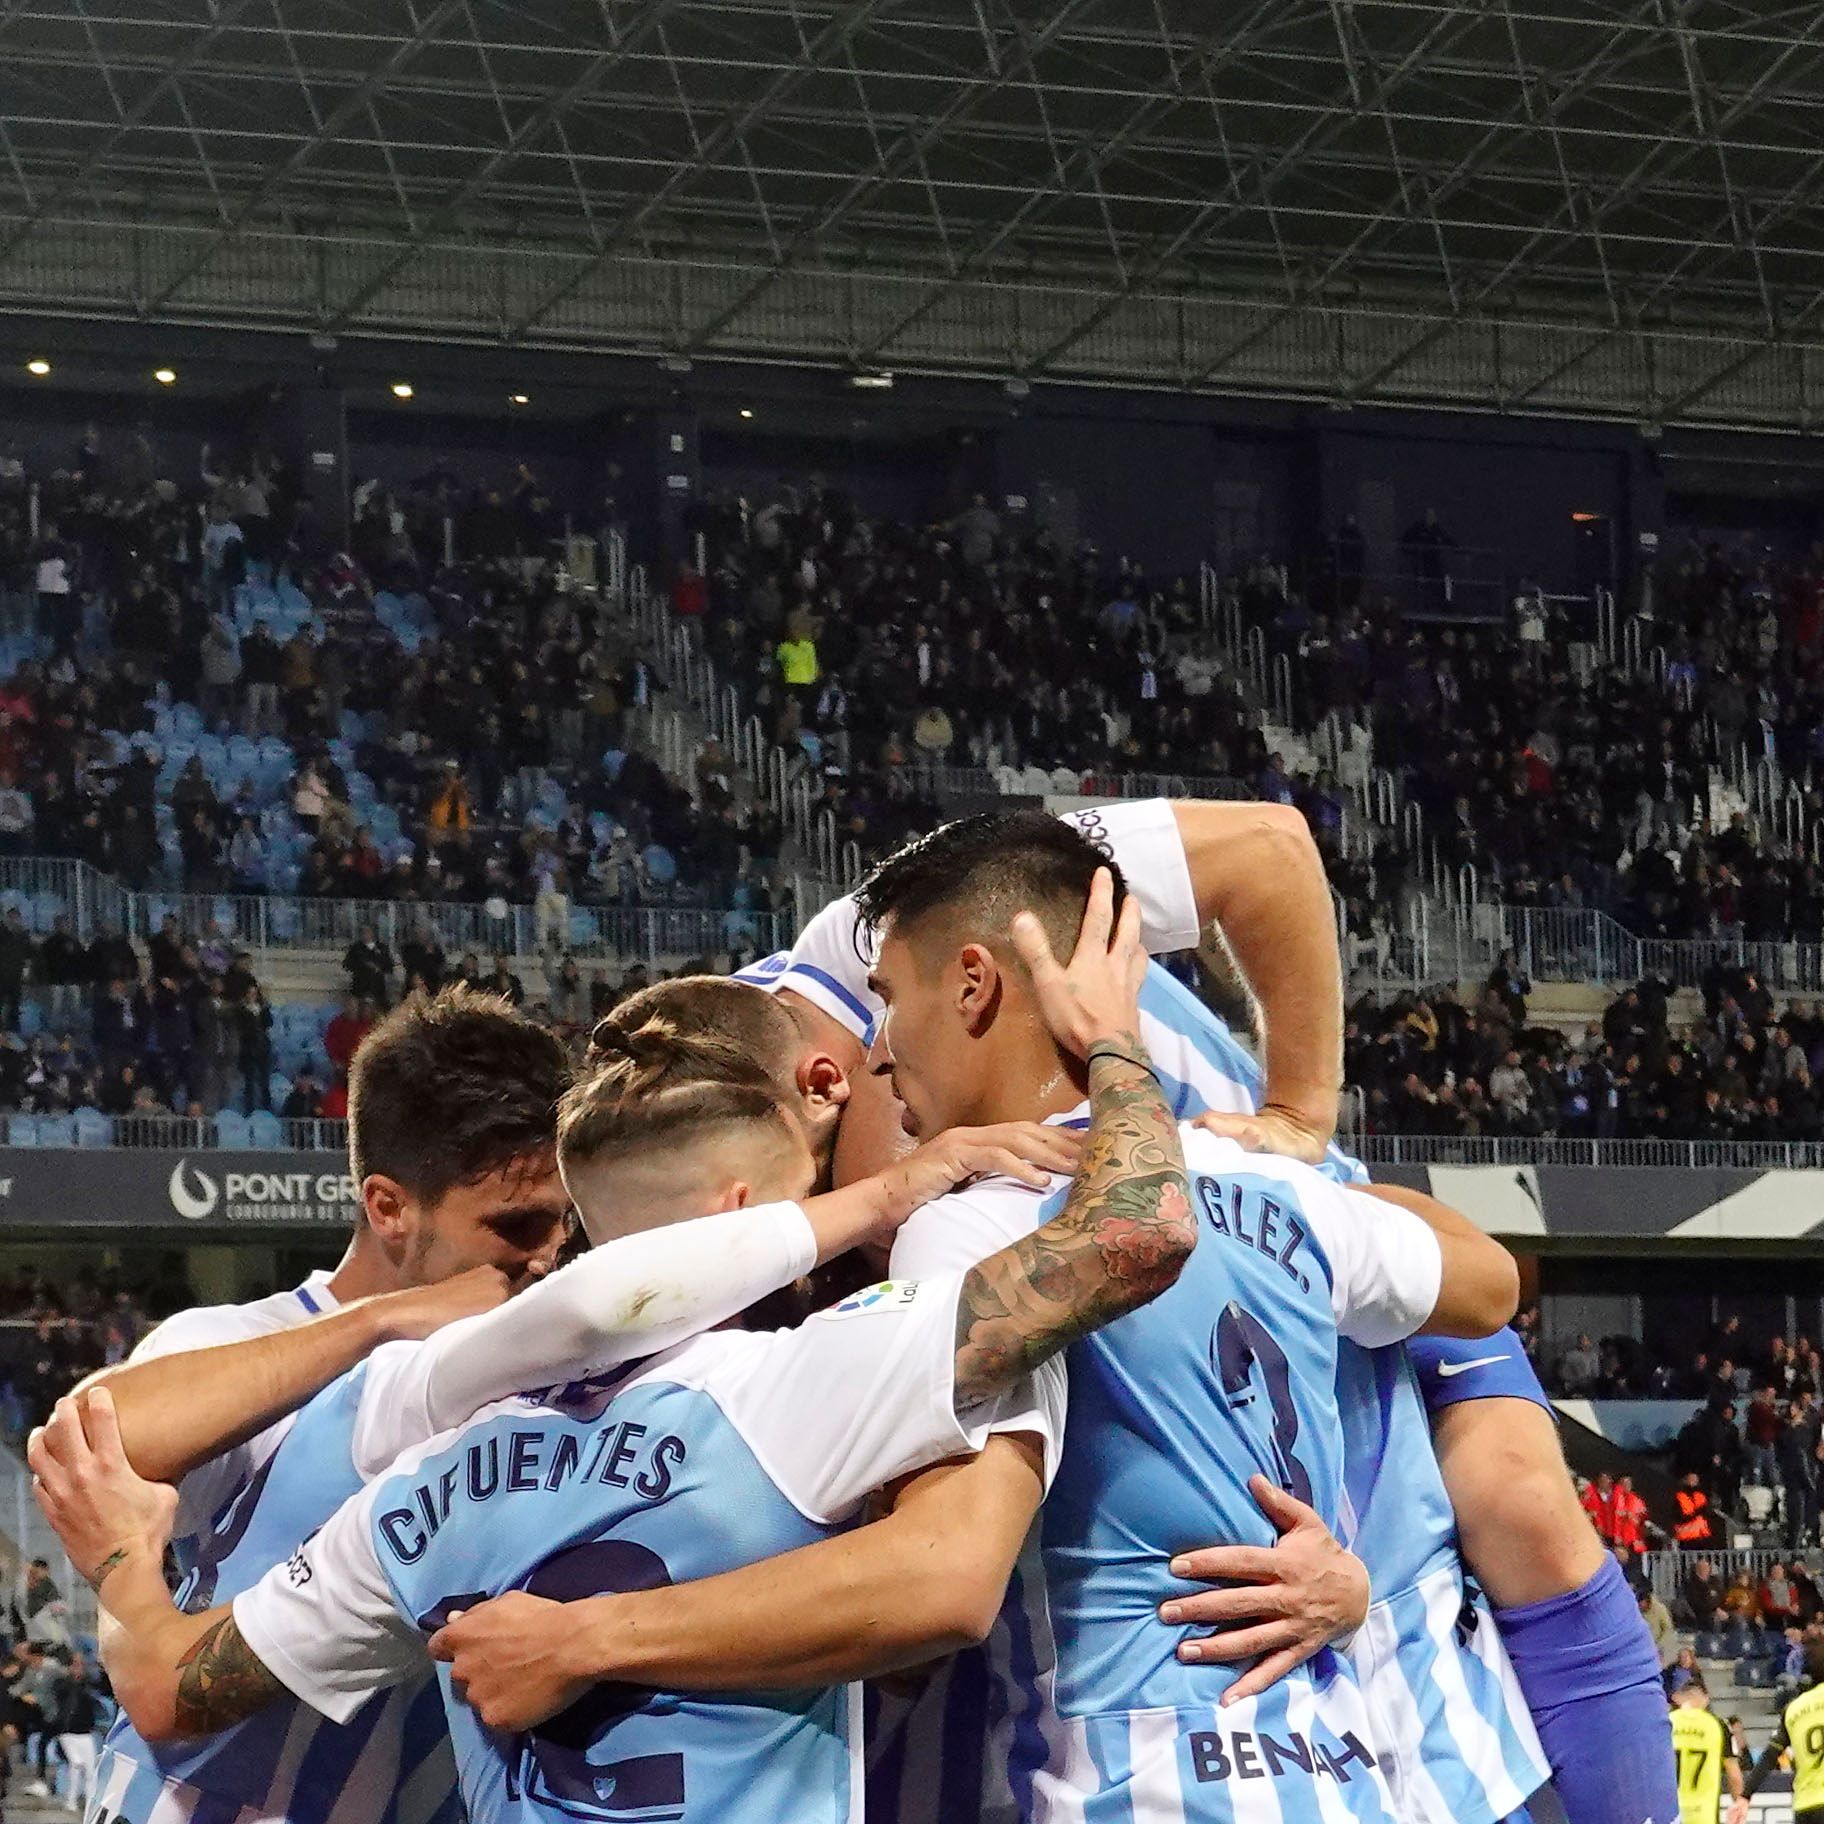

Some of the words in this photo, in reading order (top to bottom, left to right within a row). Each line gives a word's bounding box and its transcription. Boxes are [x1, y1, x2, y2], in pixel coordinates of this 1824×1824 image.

[226, 1173, 313, 1202] PONT
[316, 1173, 360, 1202] GR
[377, 1421, 687, 1566] CIFUENTES
[1188, 1730, 1378, 1784] BENAH
